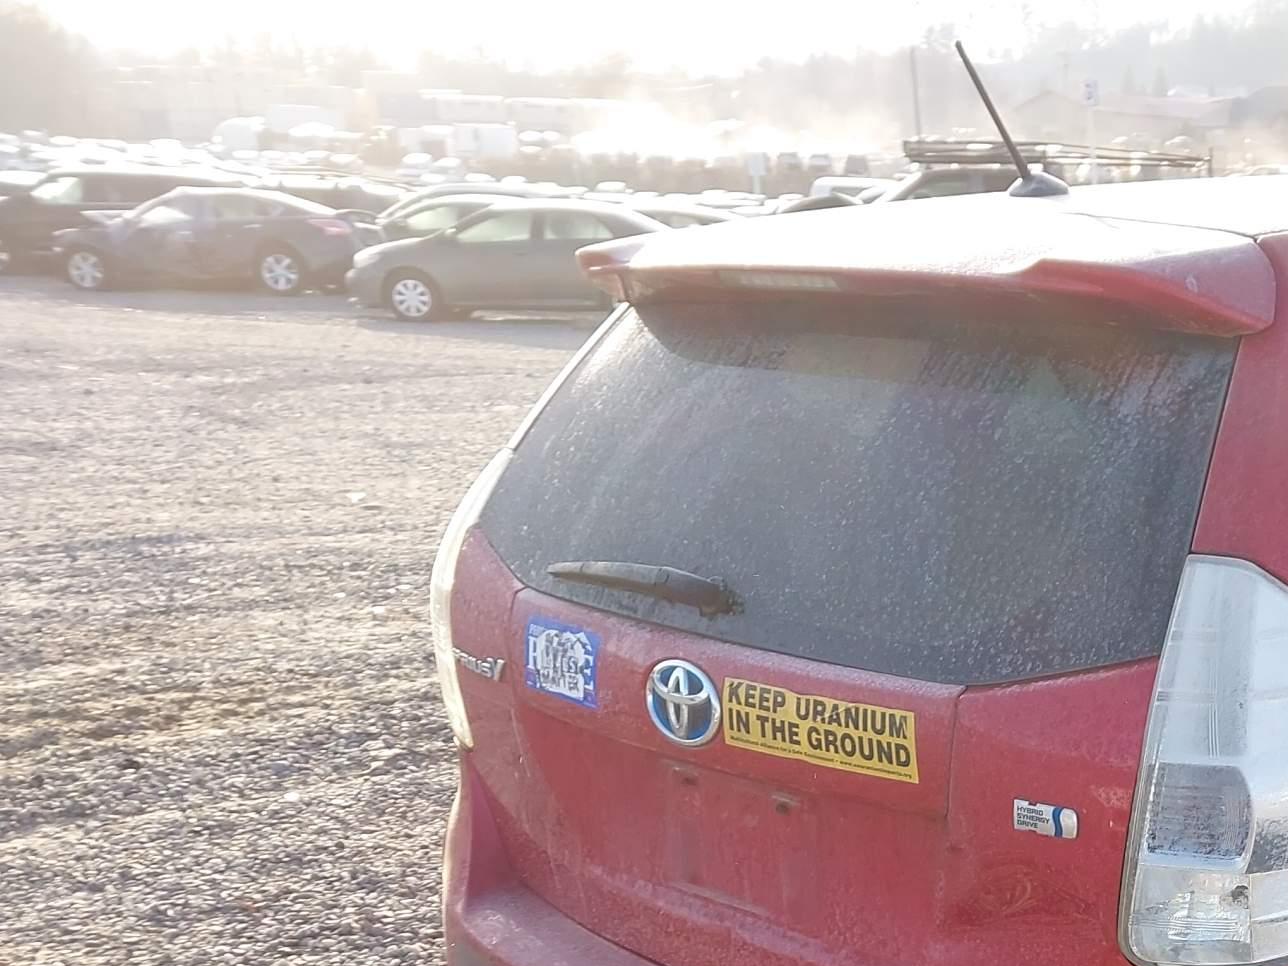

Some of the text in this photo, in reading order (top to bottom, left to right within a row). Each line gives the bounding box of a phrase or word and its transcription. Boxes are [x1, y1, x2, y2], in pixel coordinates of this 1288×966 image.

[728, 681, 907, 739] KEEP URANIUM
[728, 708, 750, 734] IN
[756, 714, 801, 746] THE
[807, 726, 911, 767] GROUND
[1017, 806, 1043, 816] HYBRID
[1017, 813, 1049, 824] SYNERGY
[1017, 820, 1038, 828] DRIVE
